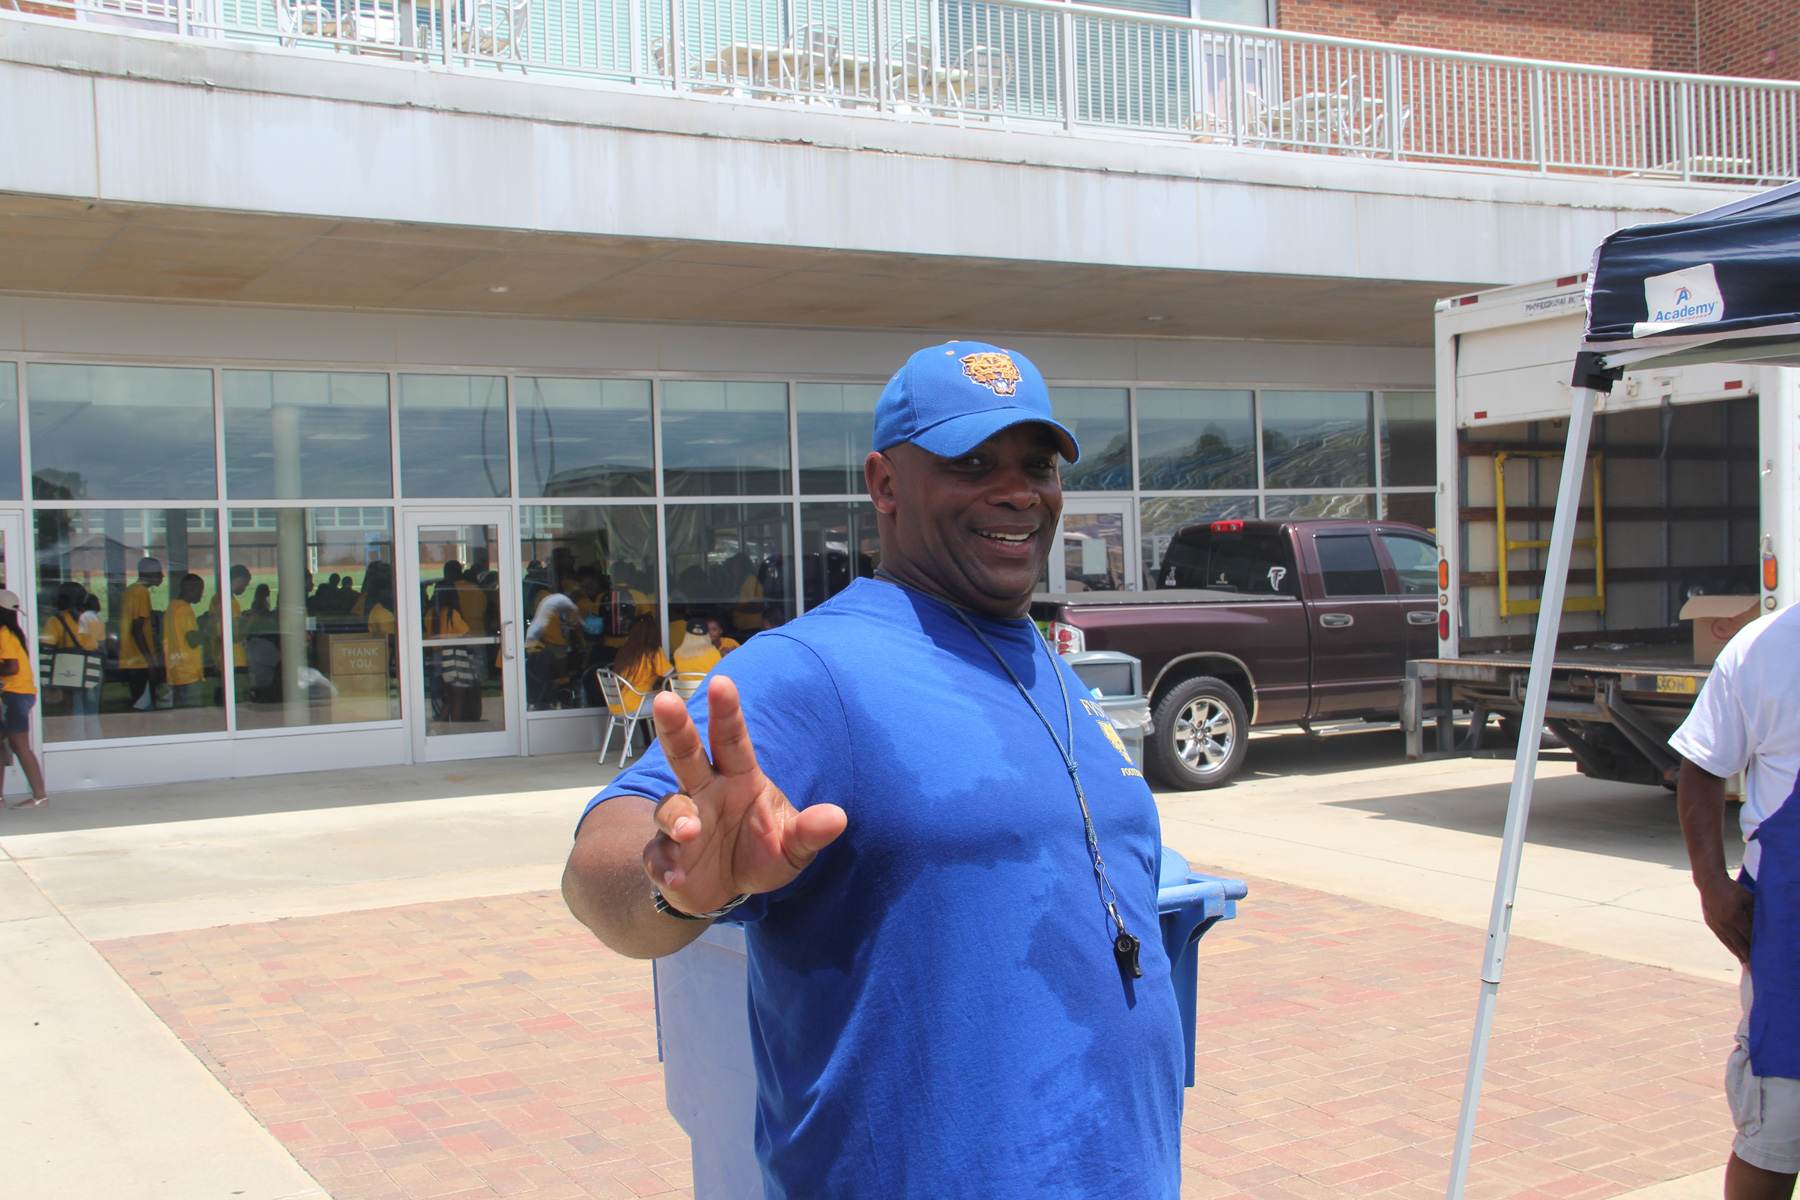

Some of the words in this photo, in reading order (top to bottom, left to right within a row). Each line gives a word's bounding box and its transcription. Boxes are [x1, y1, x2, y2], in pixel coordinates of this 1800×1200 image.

[1654, 302, 1715, 322] Academy
[340, 647, 379, 657] THANK
[349, 658, 373, 669] YOU
